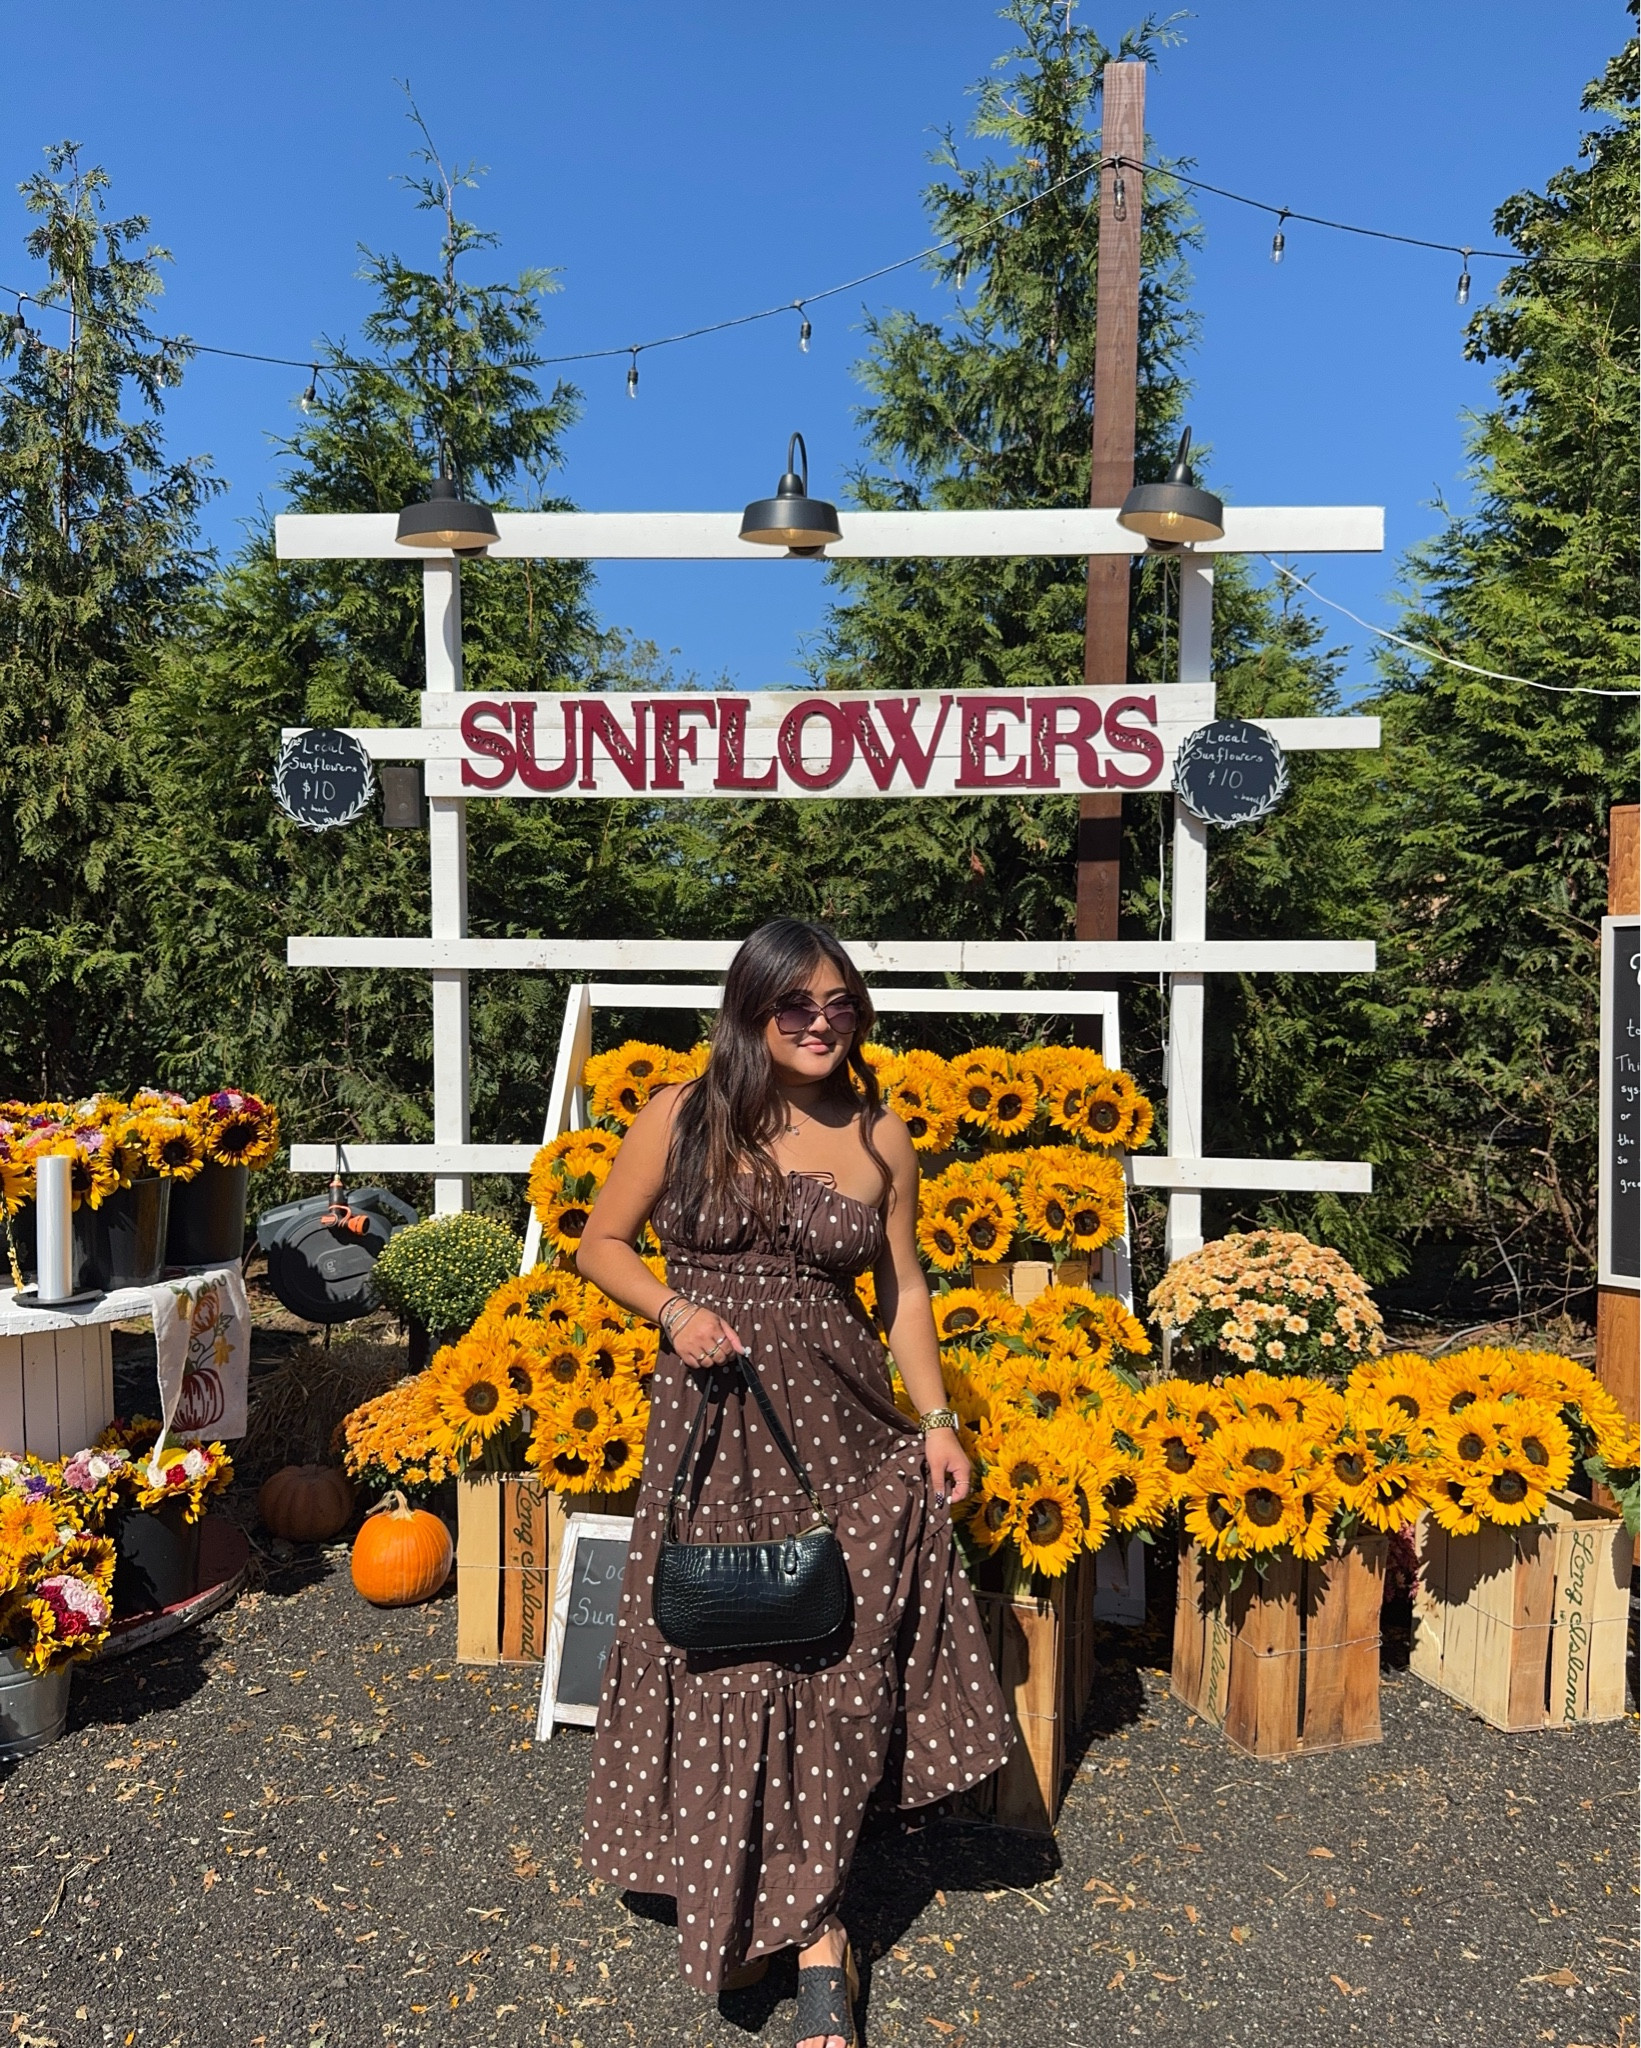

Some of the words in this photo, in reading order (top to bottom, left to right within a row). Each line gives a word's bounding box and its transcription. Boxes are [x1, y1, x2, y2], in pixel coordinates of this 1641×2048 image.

[302, 736, 345, 755] Local
[460, 694, 1165, 791] SUNFLOWERS
[1205, 727, 1249, 744] Local
[288, 756, 358, 775] Sunflowers
[1190, 746, 1264, 764] Sunflowers
[1207, 768, 1243, 789] $10
[302, 779, 336, 801] $10
[1620, 1084, 1640, 1102] sys
[1620, 1112, 1632, 1121] or
[1616, 1132, 1635, 1146] the
[514, 1477, 542, 1546] Long
[582, 1549, 626, 1585] Loc
[1564, 1530, 1594, 1607] Long
[521, 1551, 543, 1662] Island
[573, 1597, 616, 1626] Sun
[1563, 1611, 1588, 1723] Island
